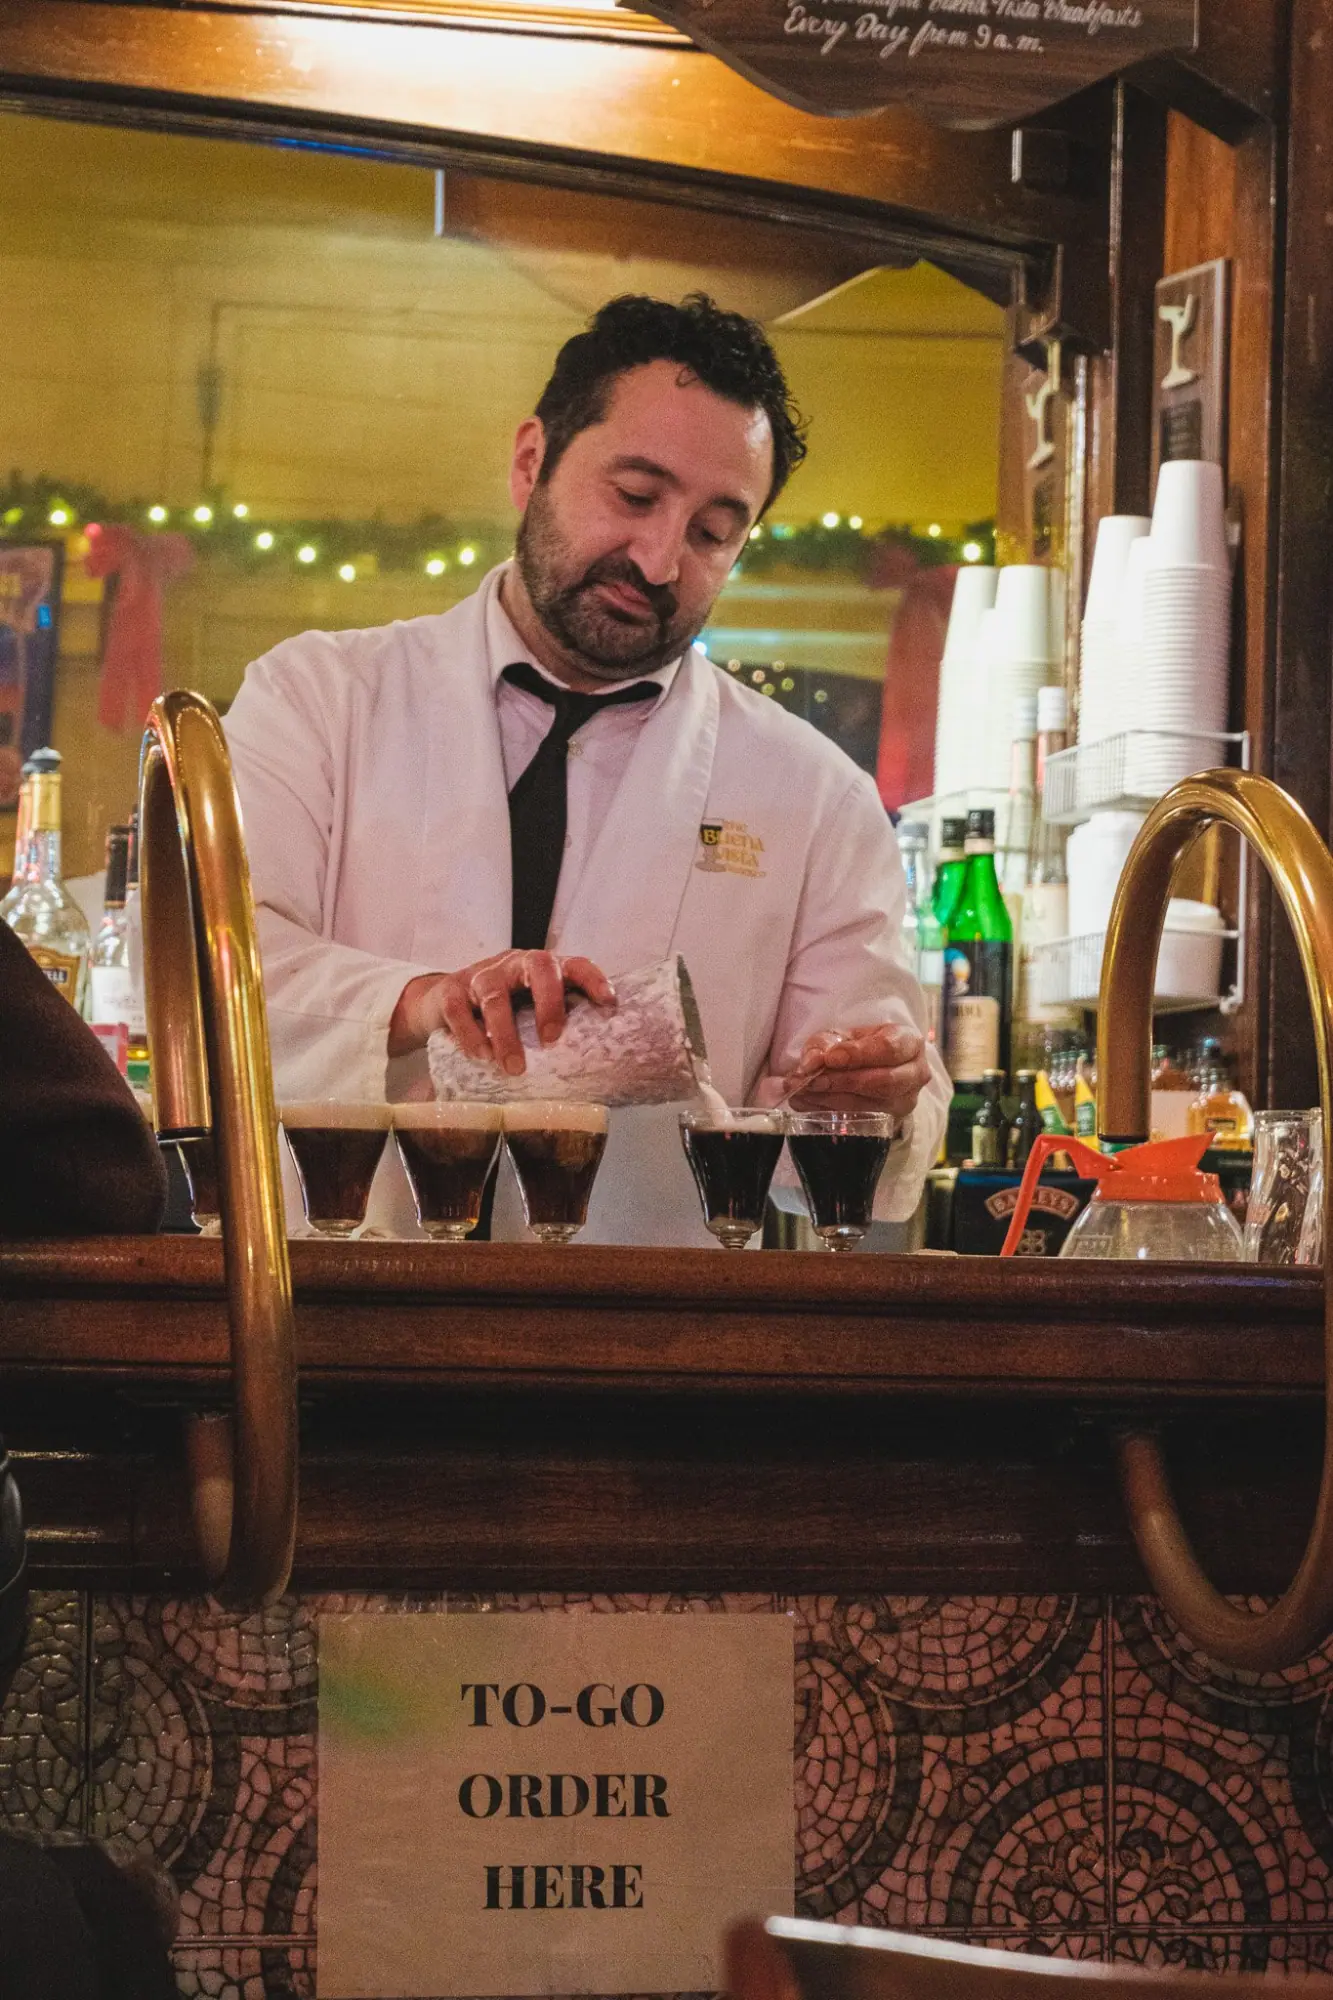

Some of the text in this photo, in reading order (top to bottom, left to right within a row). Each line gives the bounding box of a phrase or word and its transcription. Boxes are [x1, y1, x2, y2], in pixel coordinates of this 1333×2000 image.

[784, 5, 848, 56] Every
[855, 12, 911, 59] Day
[908, 20, 969, 58] from
[974, 24, 992, 48] 9
[461, 1682, 665, 1728] TO-GO
[458, 1773, 672, 1819] ORDER
[482, 1864, 644, 1910] HERE
